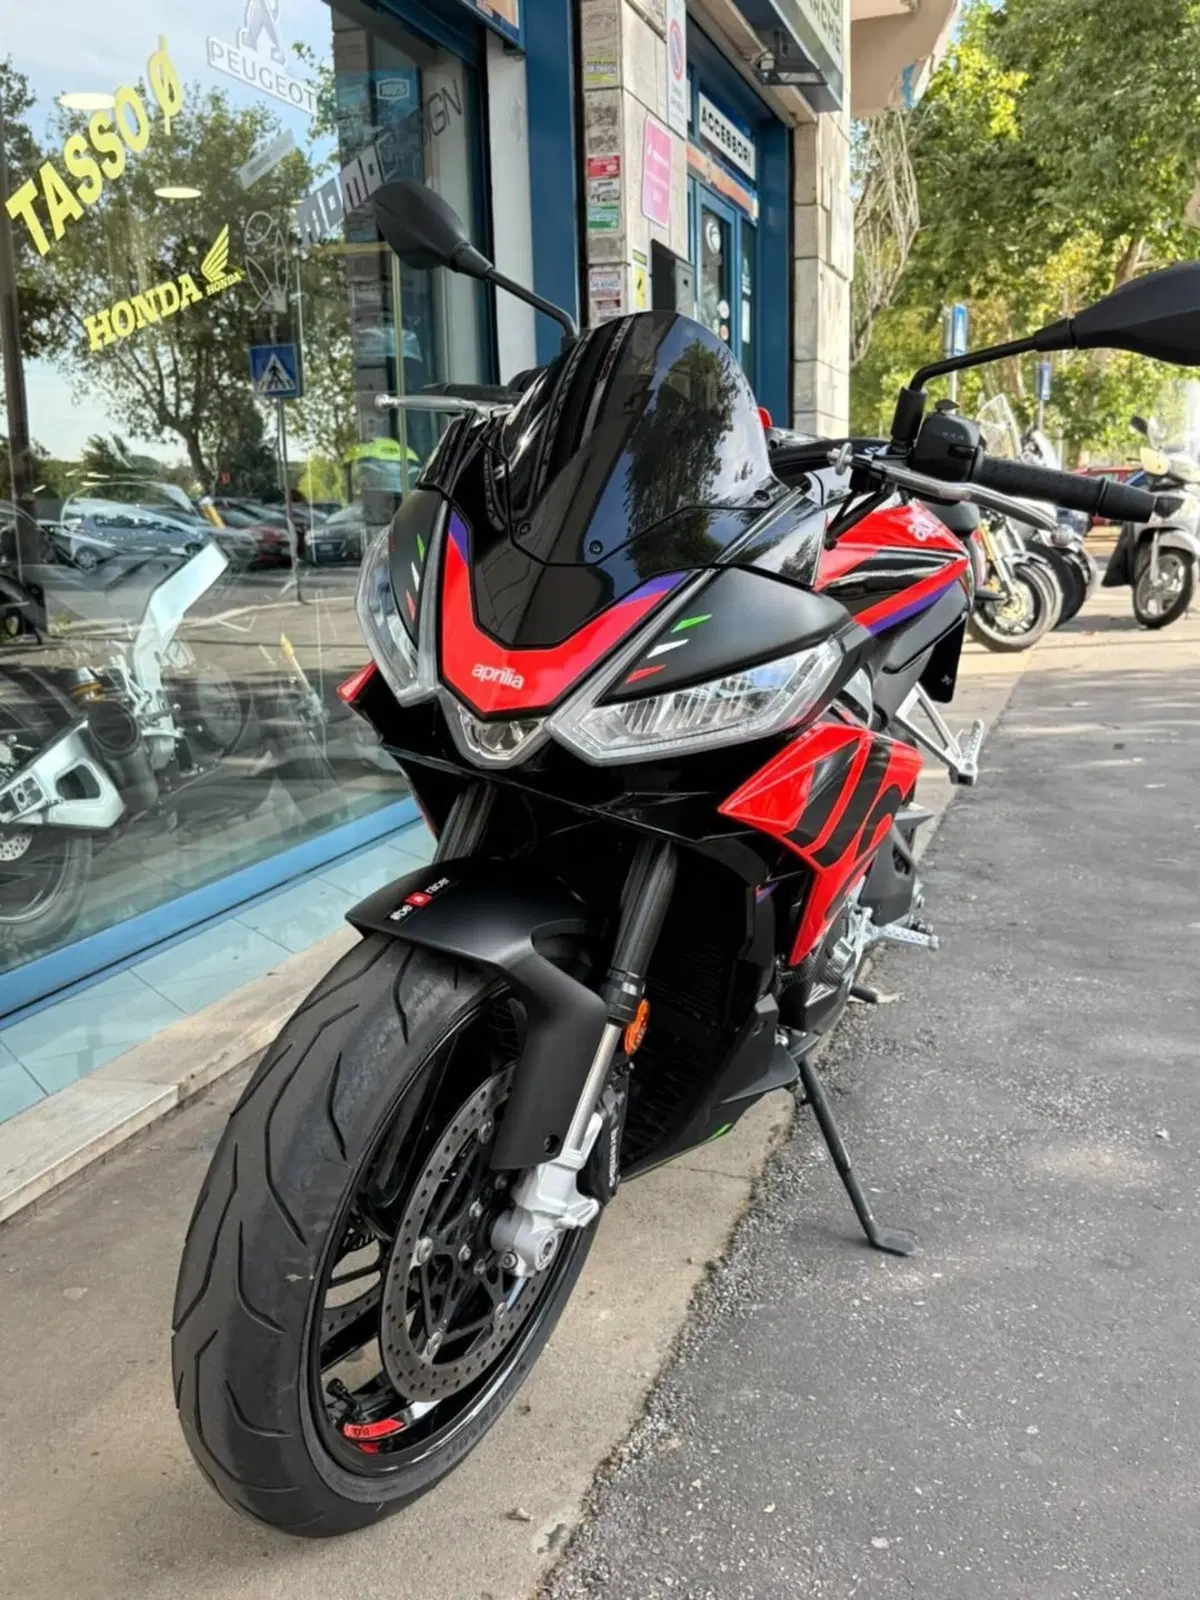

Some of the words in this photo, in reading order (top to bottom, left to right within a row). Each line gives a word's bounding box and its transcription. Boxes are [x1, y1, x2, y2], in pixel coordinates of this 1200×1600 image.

[210, 38, 315, 110] PEUGEOT
[4, 86, 150, 257] TASSO
[83, 273, 203, 352] HONDA
[205, 272, 242, 296] HONDA
[471, 663, 526, 690] aprilia
